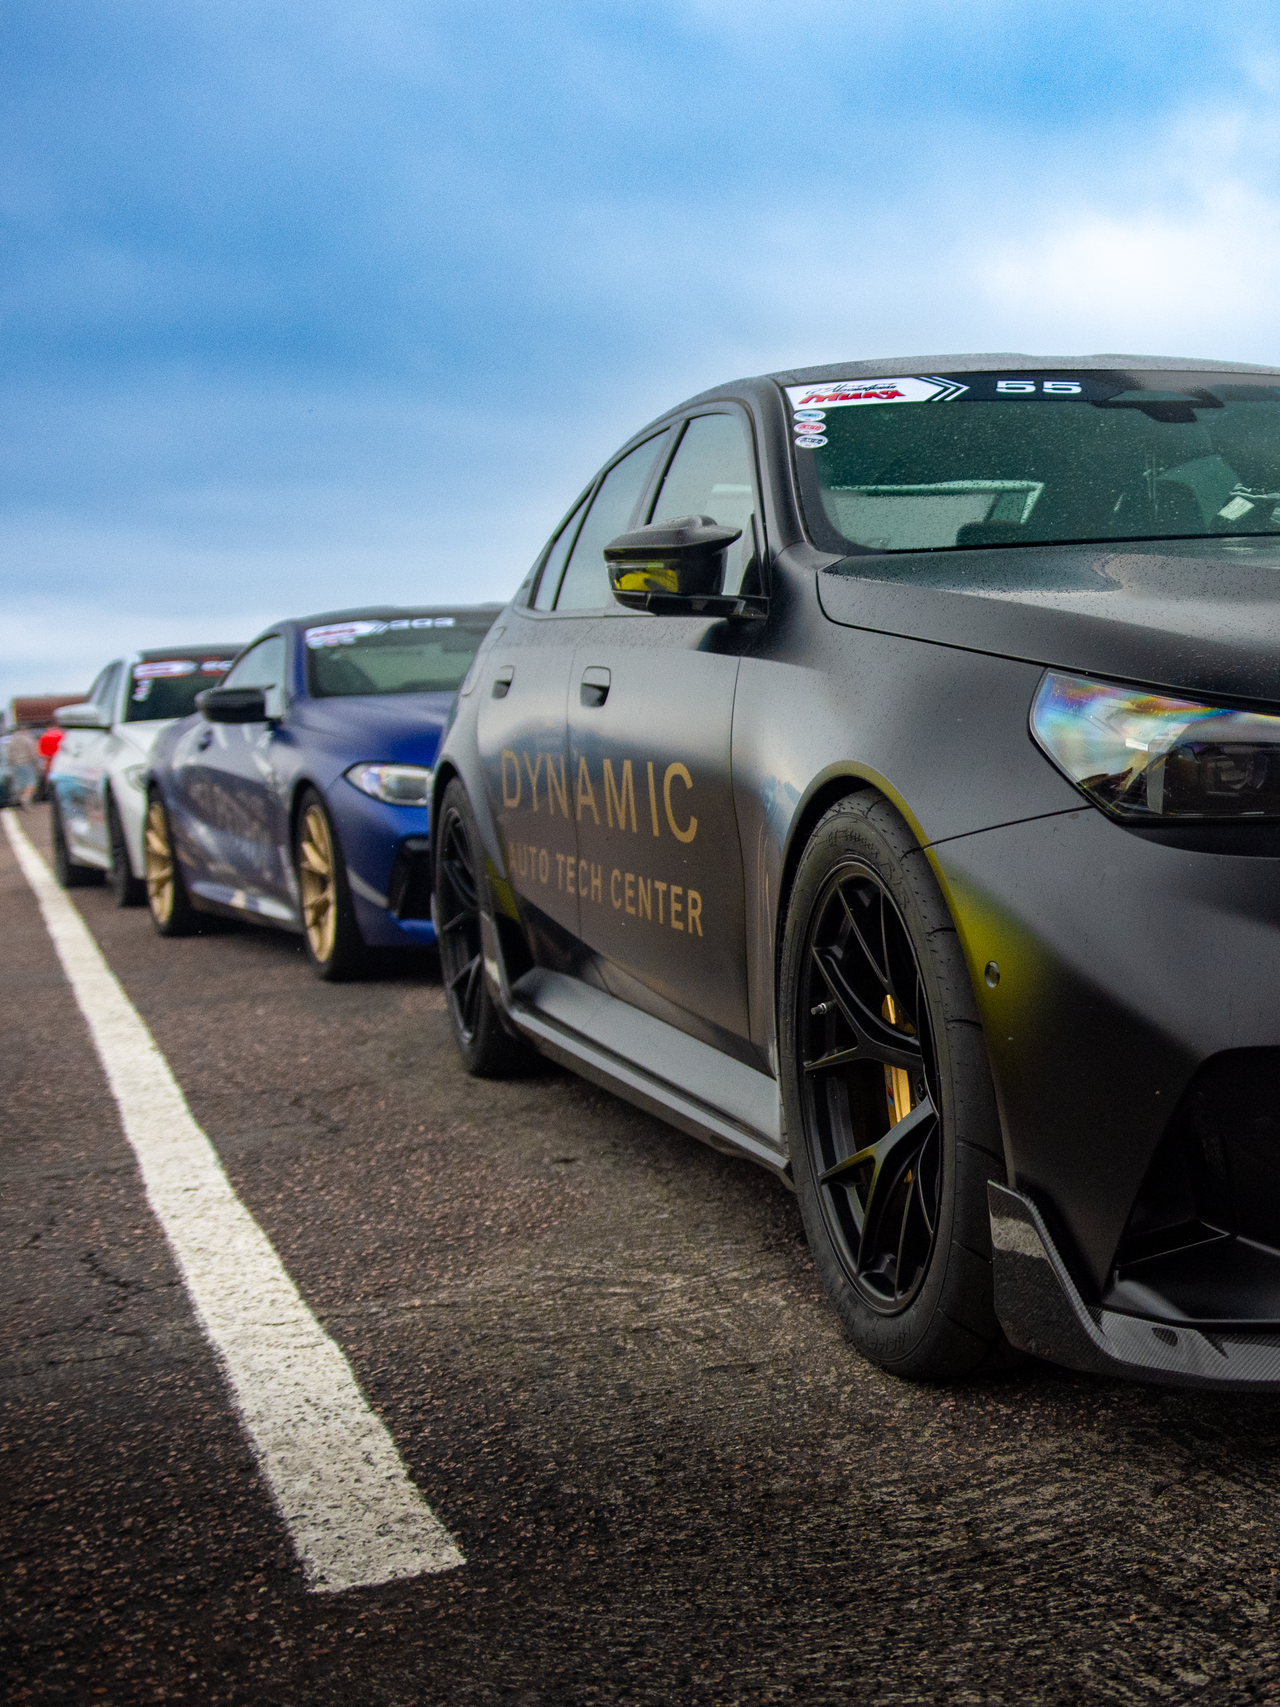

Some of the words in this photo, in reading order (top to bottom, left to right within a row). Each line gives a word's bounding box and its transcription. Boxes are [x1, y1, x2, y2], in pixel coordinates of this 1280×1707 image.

[996, 380, 1083, 394] 55
[501, 749, 698, 844] DYNAMIC
[508, 841, 550, 885] AUTO
[556, 852, 602, 904] TECH
[610, 868, 704, 937] CENTER
